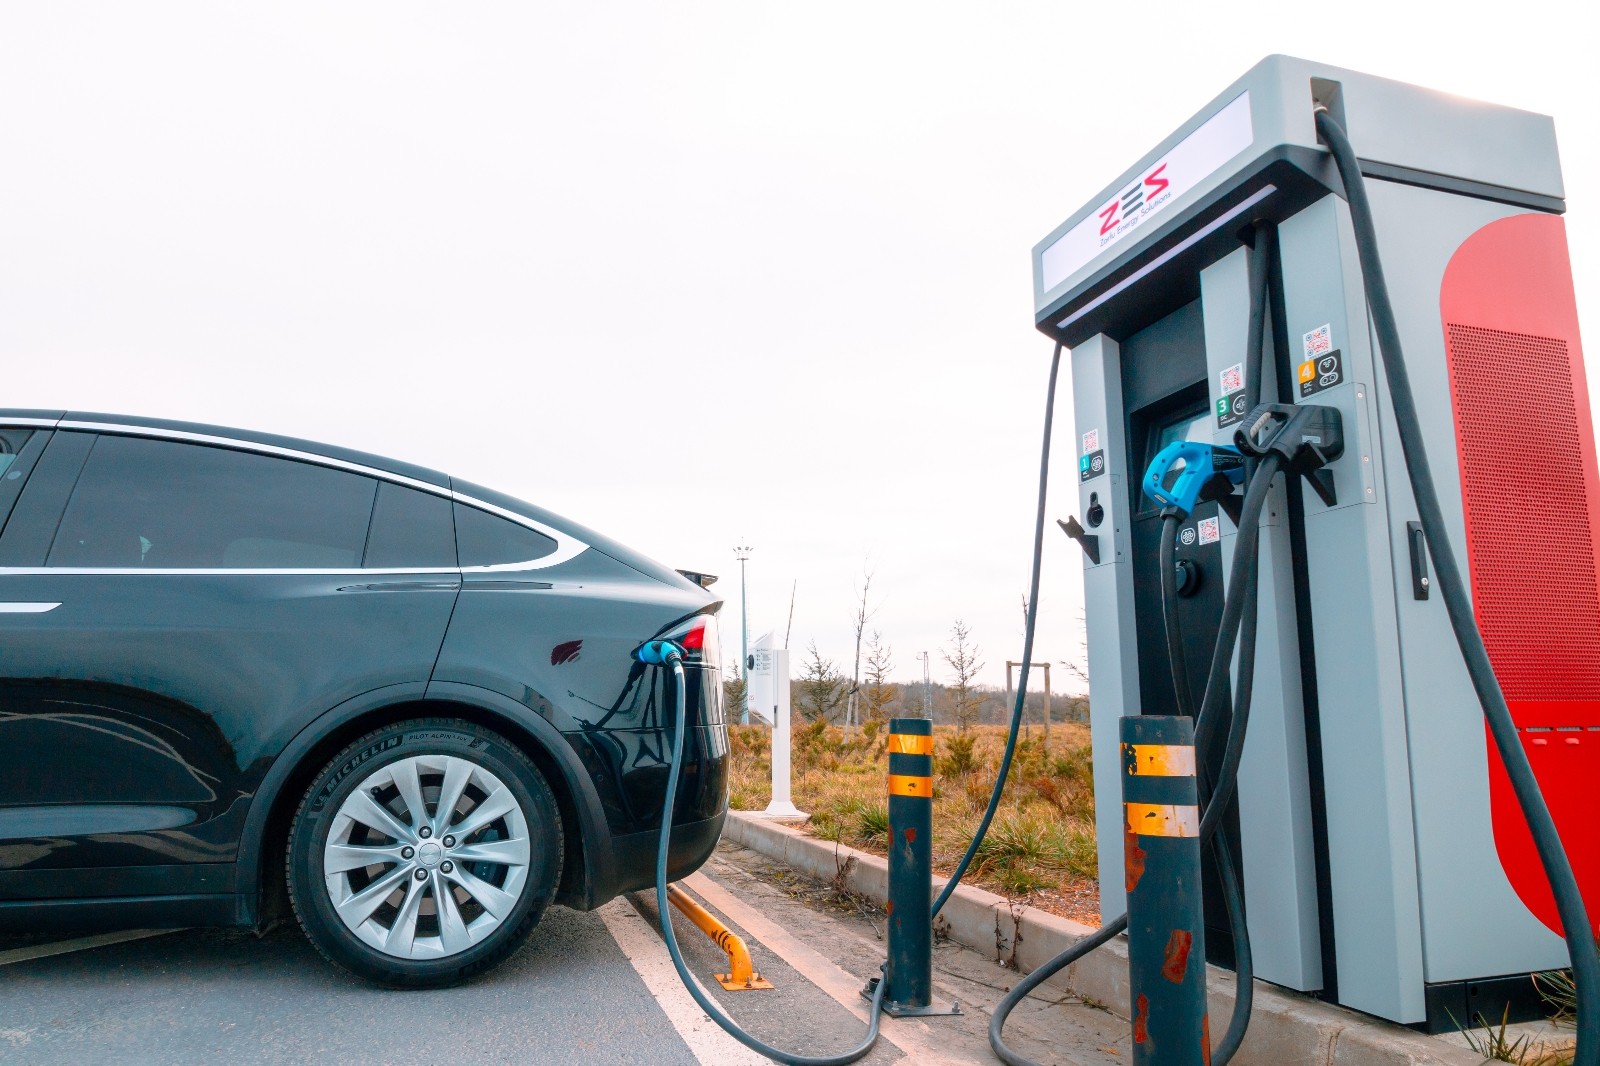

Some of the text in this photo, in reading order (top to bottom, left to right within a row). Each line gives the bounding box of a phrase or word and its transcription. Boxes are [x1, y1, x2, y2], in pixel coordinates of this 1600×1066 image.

[1099, 162, 1169, 237] ZES
[1099, 191, 1172, 248] Zorlu Energy Solutions
[1301, 363, 1311, 378] 4
[1218, 399, 1226, 413] 3
[1082, 458, 1087, 469] 1
[408, 733, 429, 741] PILOT
[325, 736, 399, 793] MICHELIN
